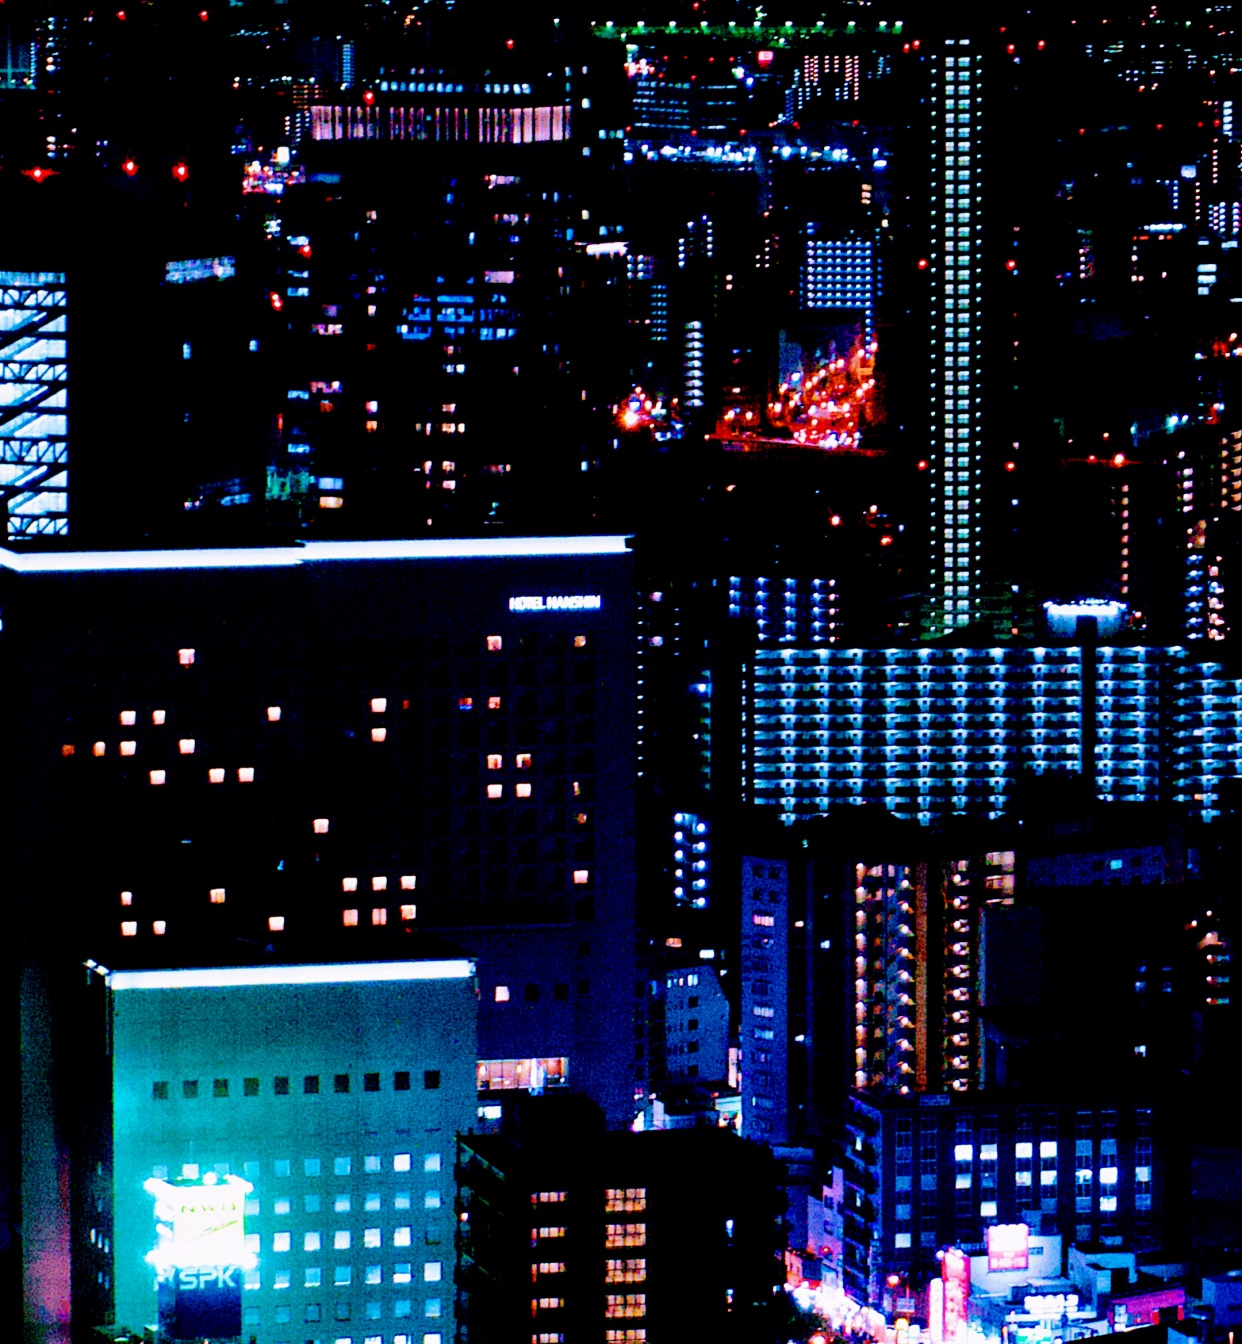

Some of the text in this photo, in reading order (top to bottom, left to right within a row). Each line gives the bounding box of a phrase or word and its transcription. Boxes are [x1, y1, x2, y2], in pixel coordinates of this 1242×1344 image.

[509, 595, 601, 610] HOTEL HANSHIN
[179, 1266, 237, 1291] SPK
